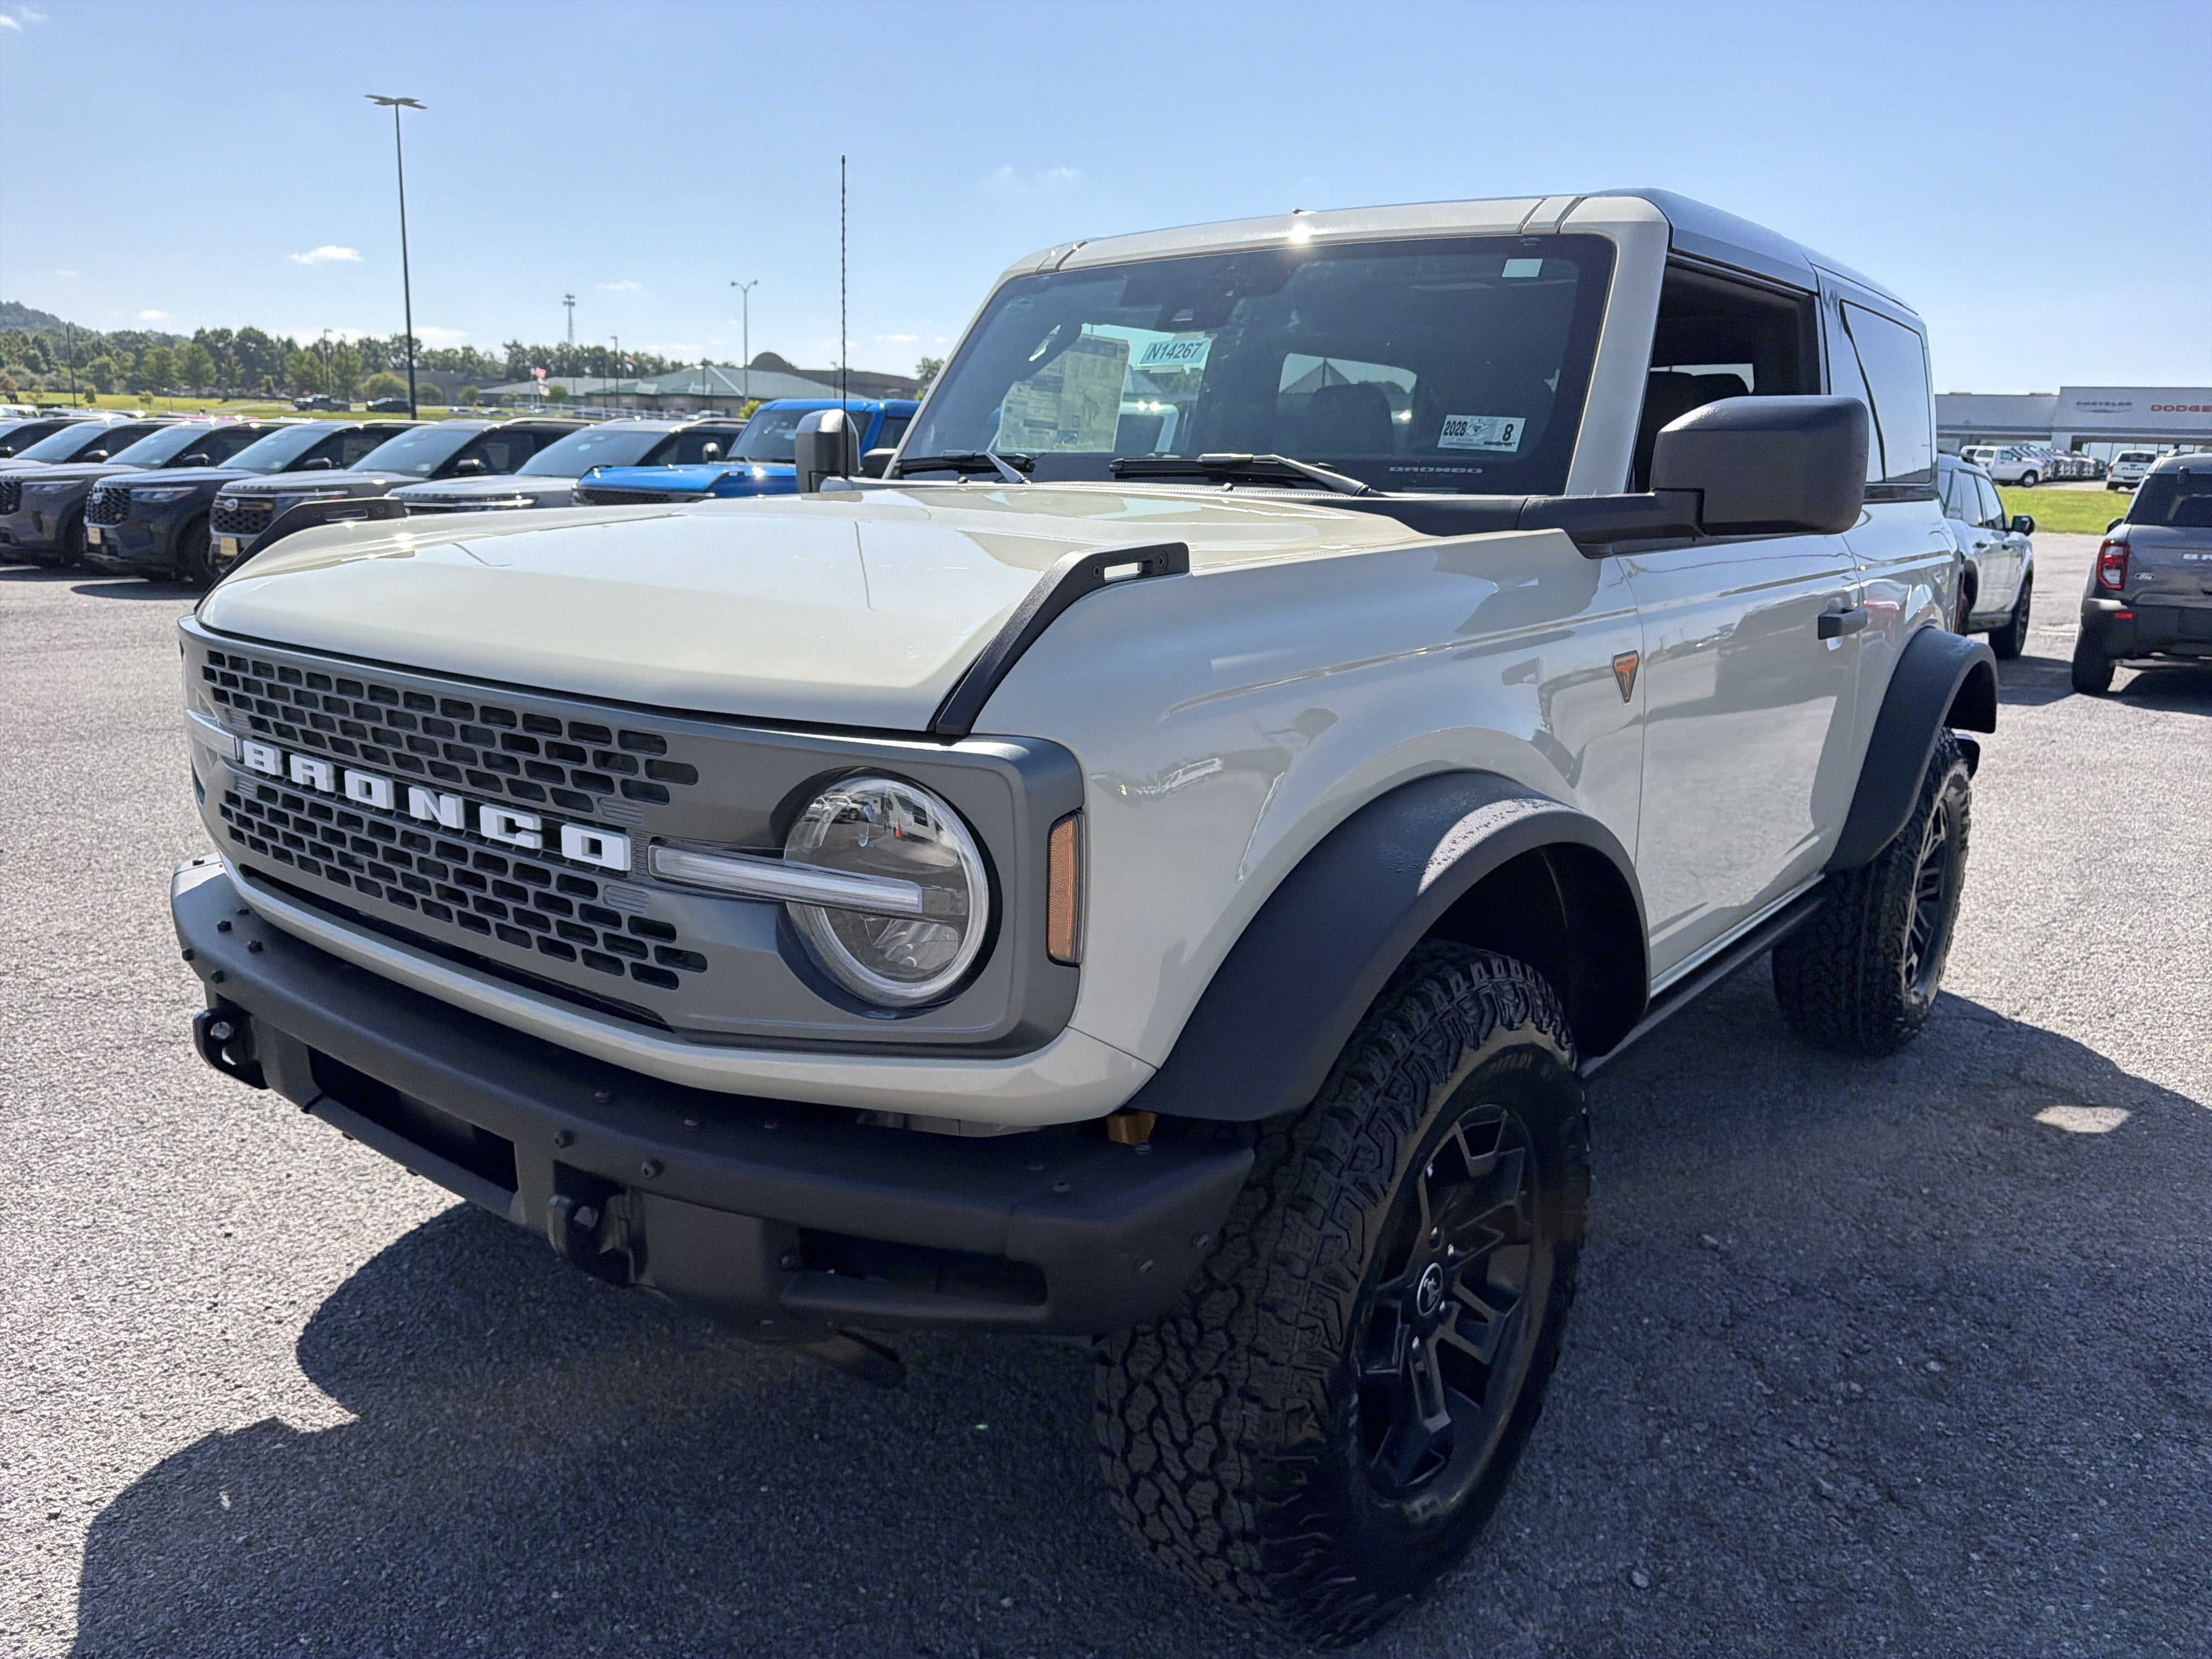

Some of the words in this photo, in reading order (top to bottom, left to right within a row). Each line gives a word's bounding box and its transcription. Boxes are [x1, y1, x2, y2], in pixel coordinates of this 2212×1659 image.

[1147, 342, 1203, 360] N14267
[1443, 421, 1468, 436] 2028
[1502, 424, 1514, 441] 8
[243, 740, 631, 871] BRONCO
